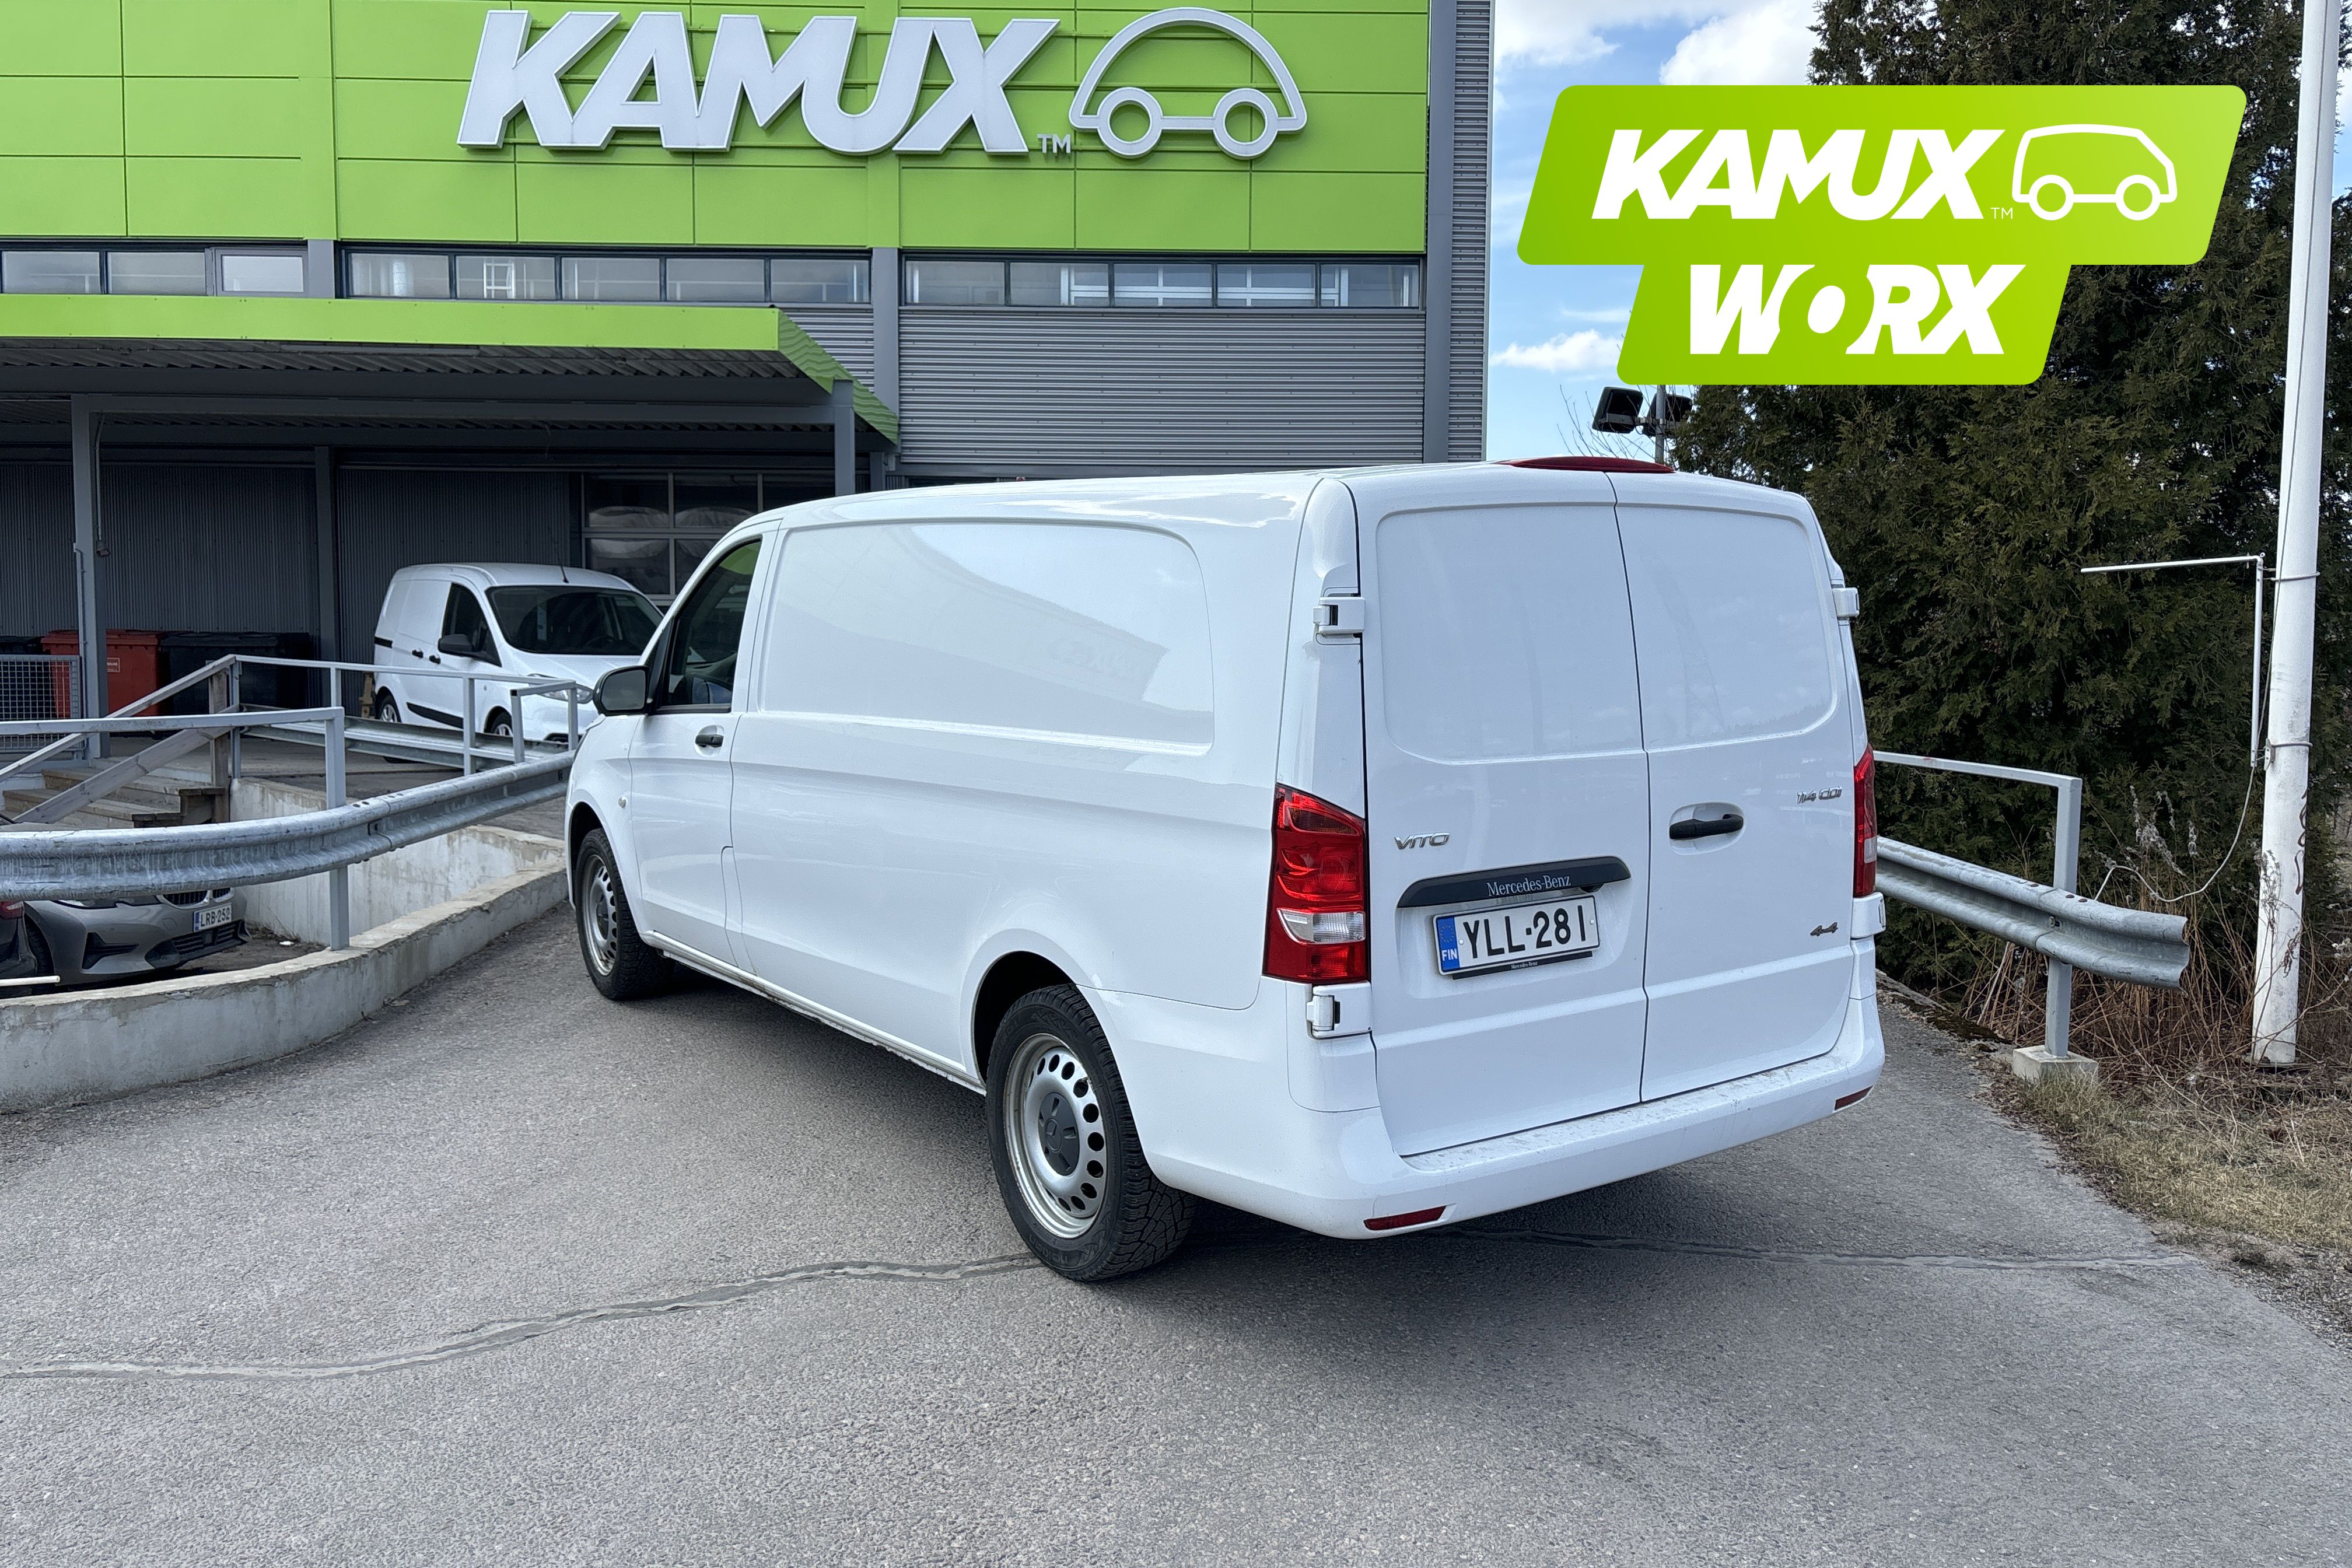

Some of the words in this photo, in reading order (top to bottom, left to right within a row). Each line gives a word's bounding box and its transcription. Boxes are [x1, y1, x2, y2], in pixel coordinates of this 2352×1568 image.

[457, 10, 1060, 156] KAMUX
[1394, 832, 1450, 849] VITO
[1486, 875, 1572, 897] Mercedes-Benz
[1462, 905, 1587, 958] YLL-281
[1441, 948, 1458, 961] FIN
